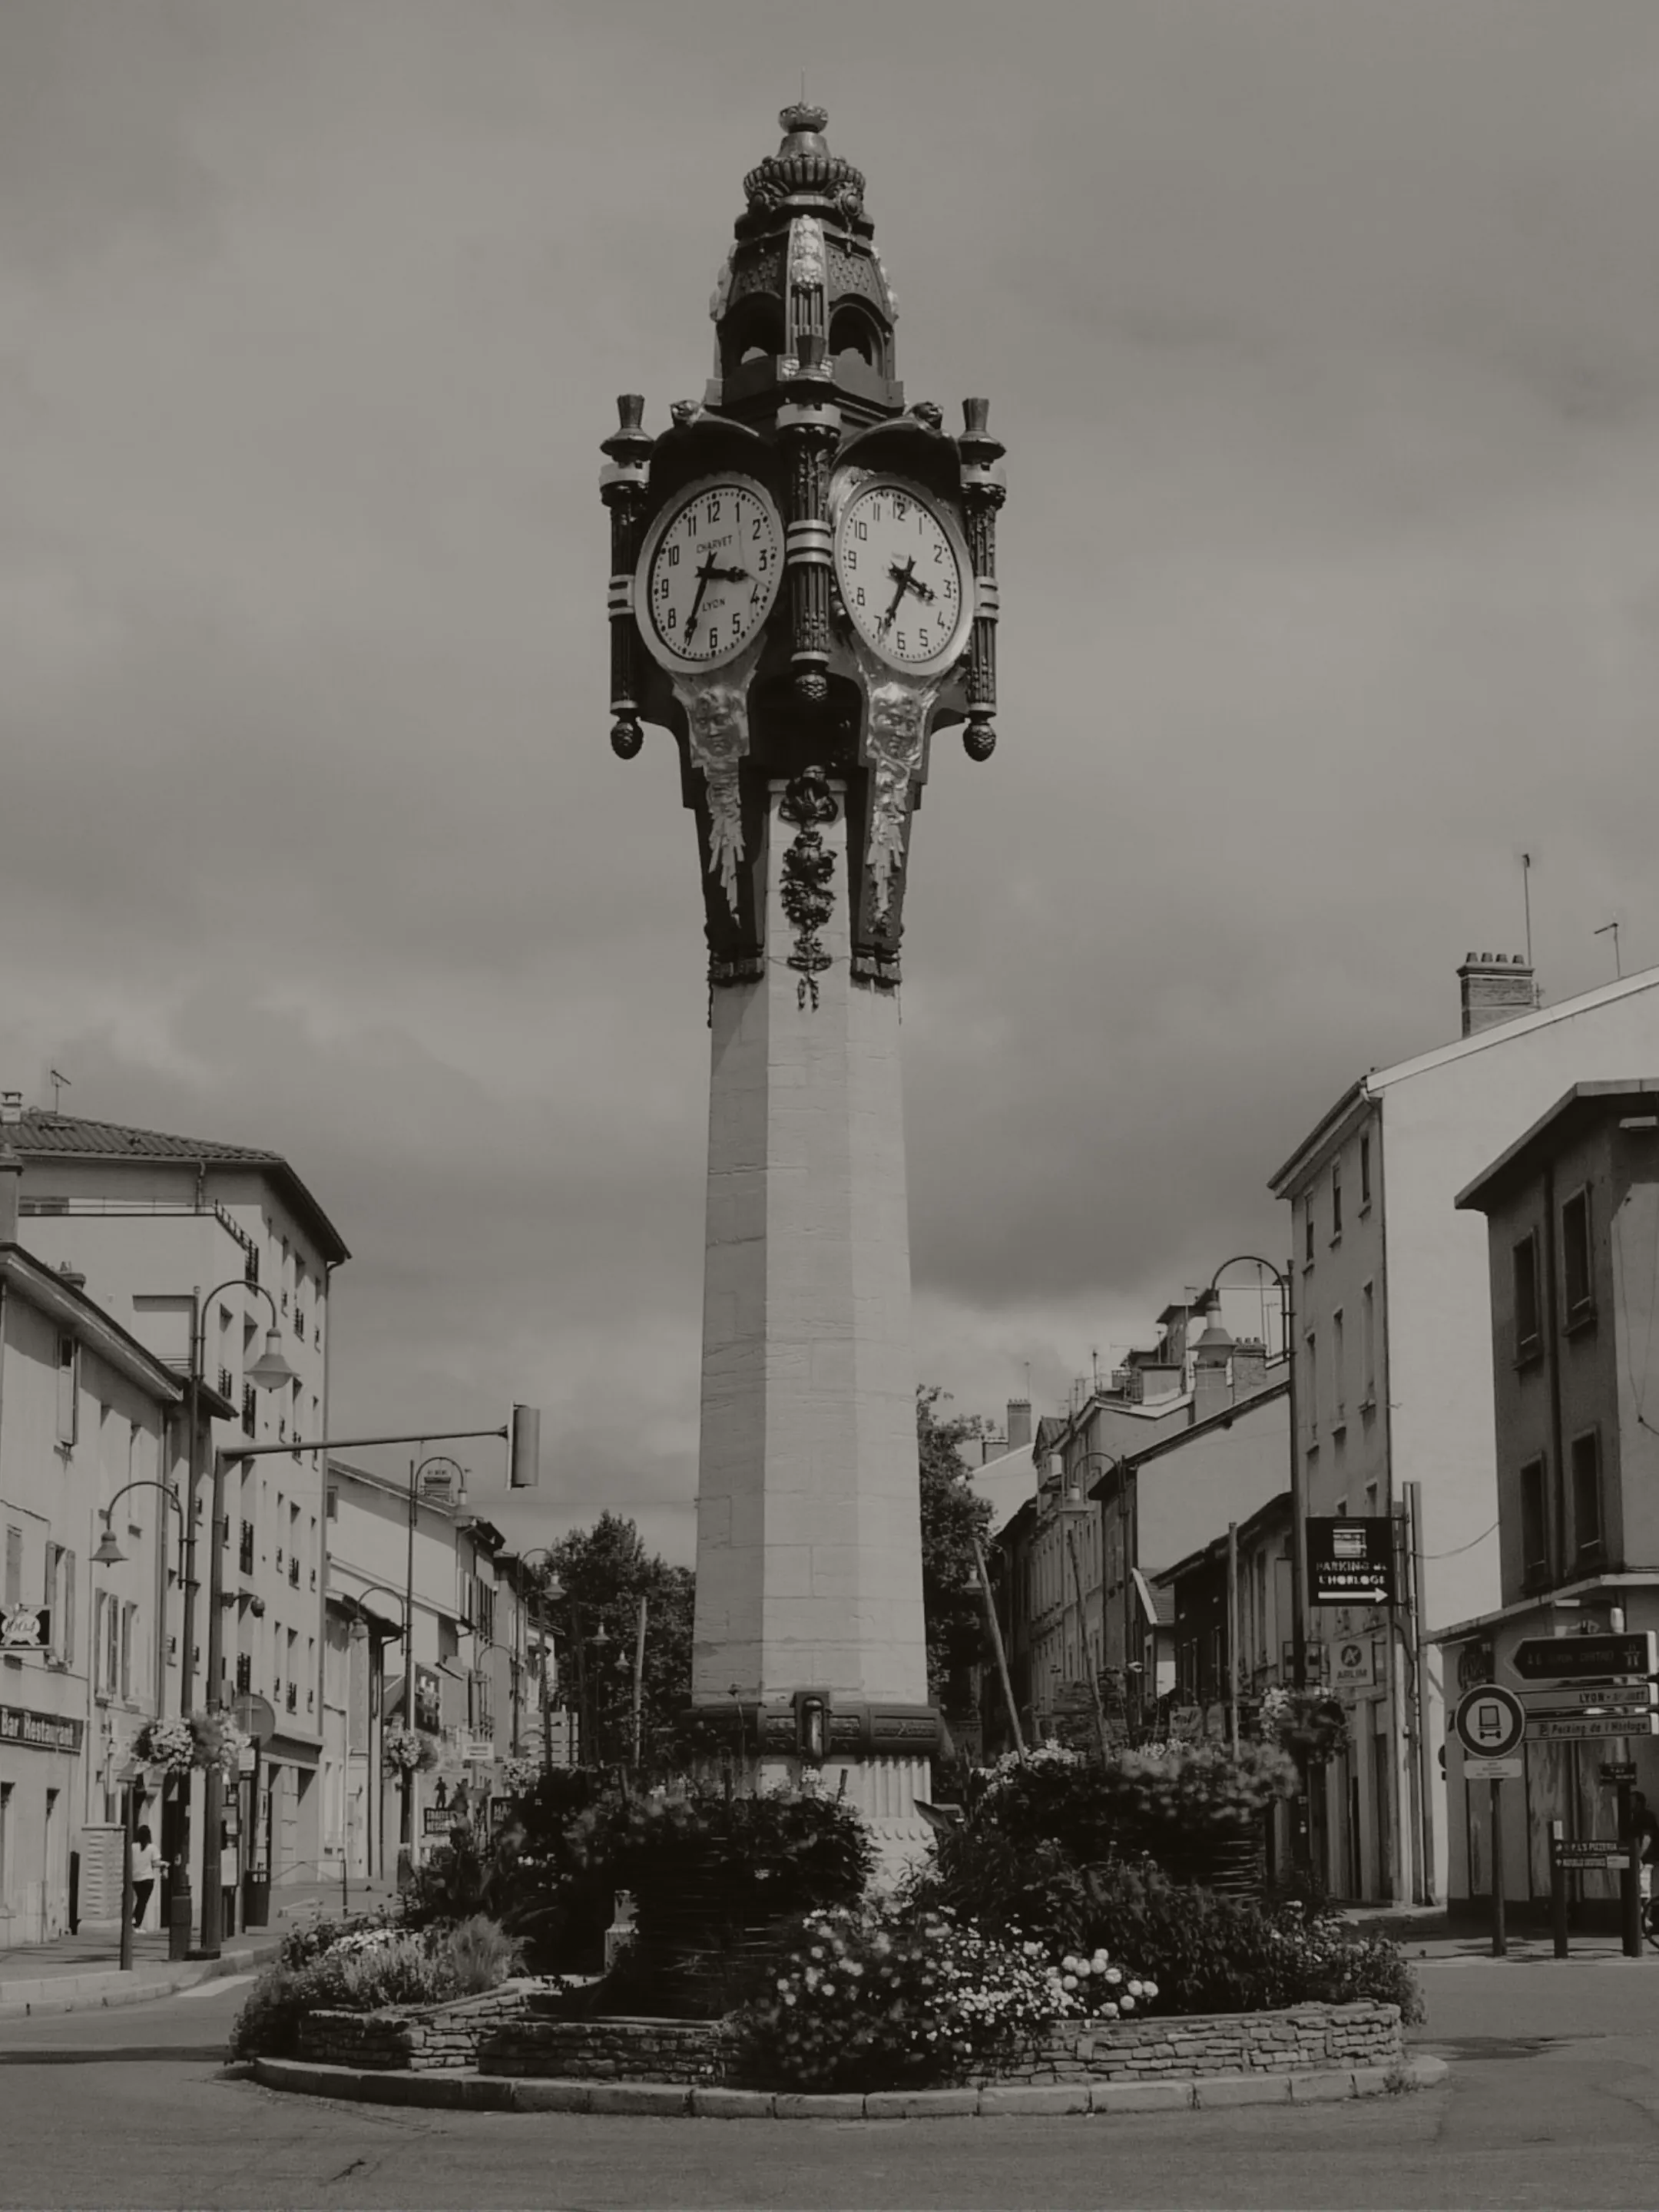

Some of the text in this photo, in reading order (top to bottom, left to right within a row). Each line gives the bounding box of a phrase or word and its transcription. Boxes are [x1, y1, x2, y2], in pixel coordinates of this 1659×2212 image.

[707, 501, 720, 524] 12
[735, 502, 740, 523] 1
[873, 502, 880, 522] 11
[892, 501, 906, 522] 12
[687, 515, 697, 537] 11
[753, 519, 761, 540] 2
[855, 520, 867, 541] 10
[697, 535, 733, 553] CHARVET
[934, 545, 942, 564] 2
[668, 545, 680, 567] 10
[759, 549, 767, 571] 3
[848, 550, 856, 570] 9
[661, 578, 669, 599] 9
[750, 584, 760, 604] 4
[856, 587, 866, 606] 8
[943, 578, 952, 599] 3
[702, 598, 726, 612] LYON
[667, 608, 676, 629] 8
[732, 612, 740, 634] 5
[874, 614, 882, 635] 7
[937, 611, 945, 628] 4
[710, 628, 717, 648] 6
[897, 631, 906, 651] 6
[919, 628, 928, 647] 5
[1316, 1561, 1369, 1571] PARKING
[1579, 1691, 1604, 1704] LYON
[2, 1707, 74, 1747] Bar Restaurant
